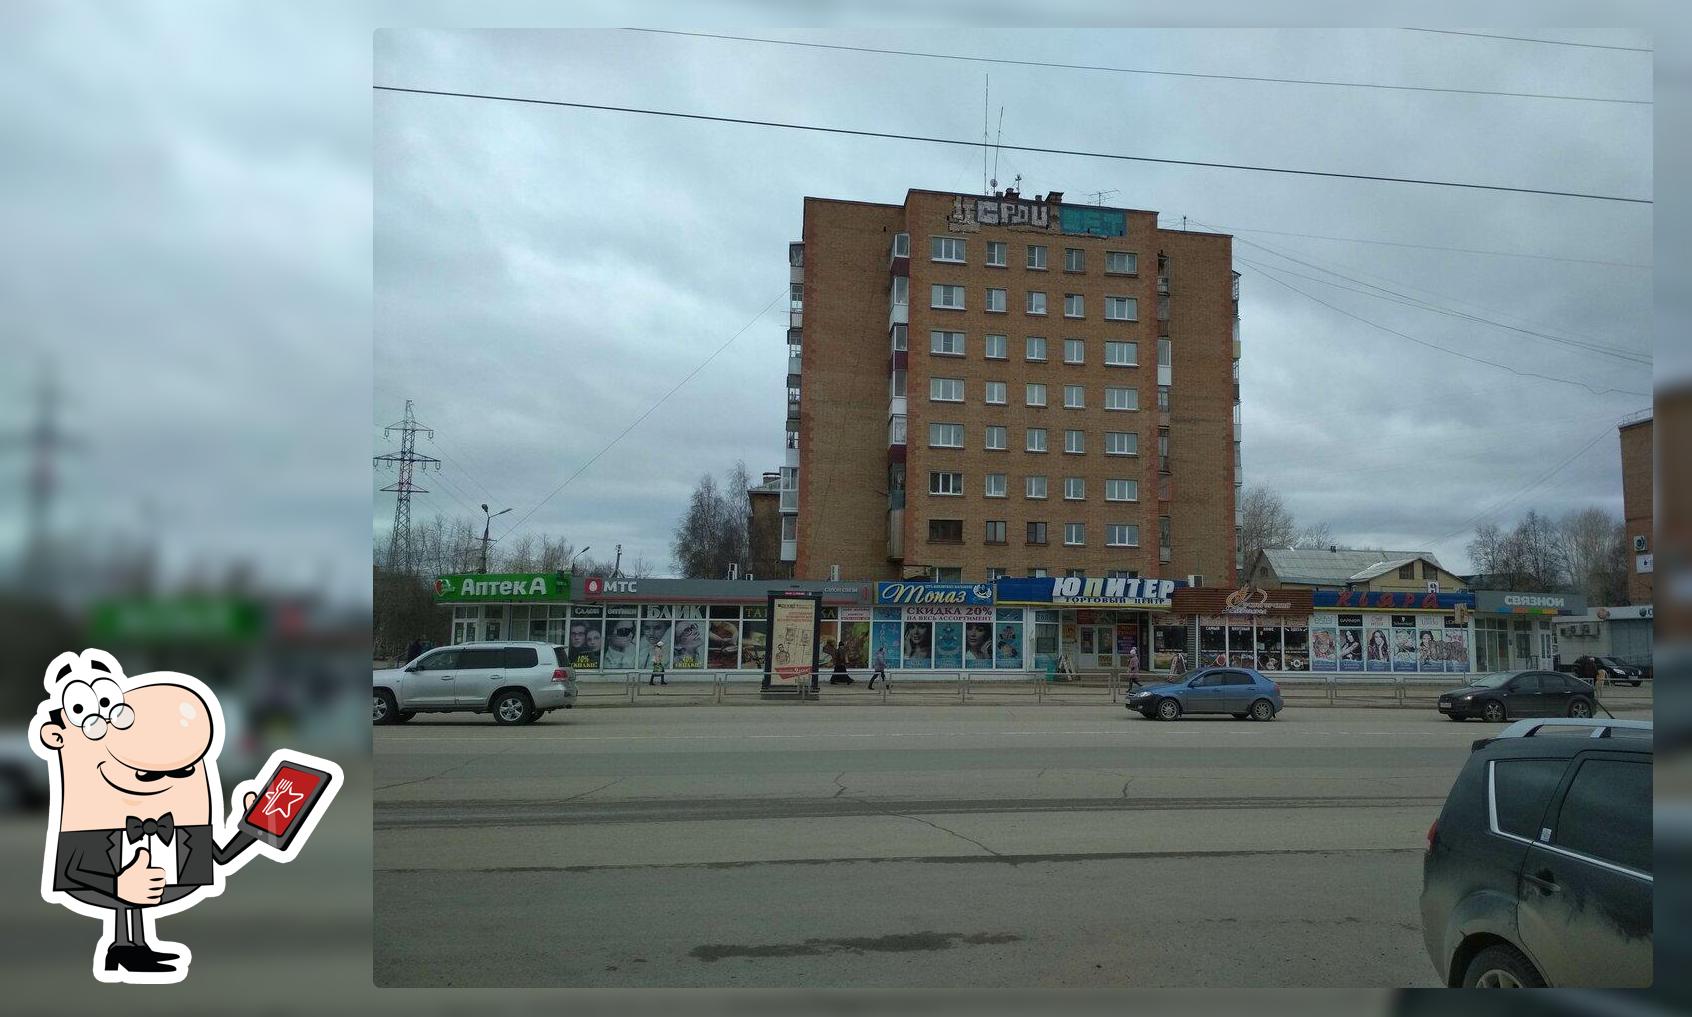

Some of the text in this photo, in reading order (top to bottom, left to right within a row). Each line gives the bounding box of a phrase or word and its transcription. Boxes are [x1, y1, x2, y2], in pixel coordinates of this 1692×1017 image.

[603, 580, 637, 593] МТС
[1052, 577, 1175, 599] ЮПИТЕР
[1504, 595, 1564, 608] СВЯЗНОЙ
[646, 605, 702, 619] БЛИК
[907, 607, 993, 616] СКИДКА 20%
